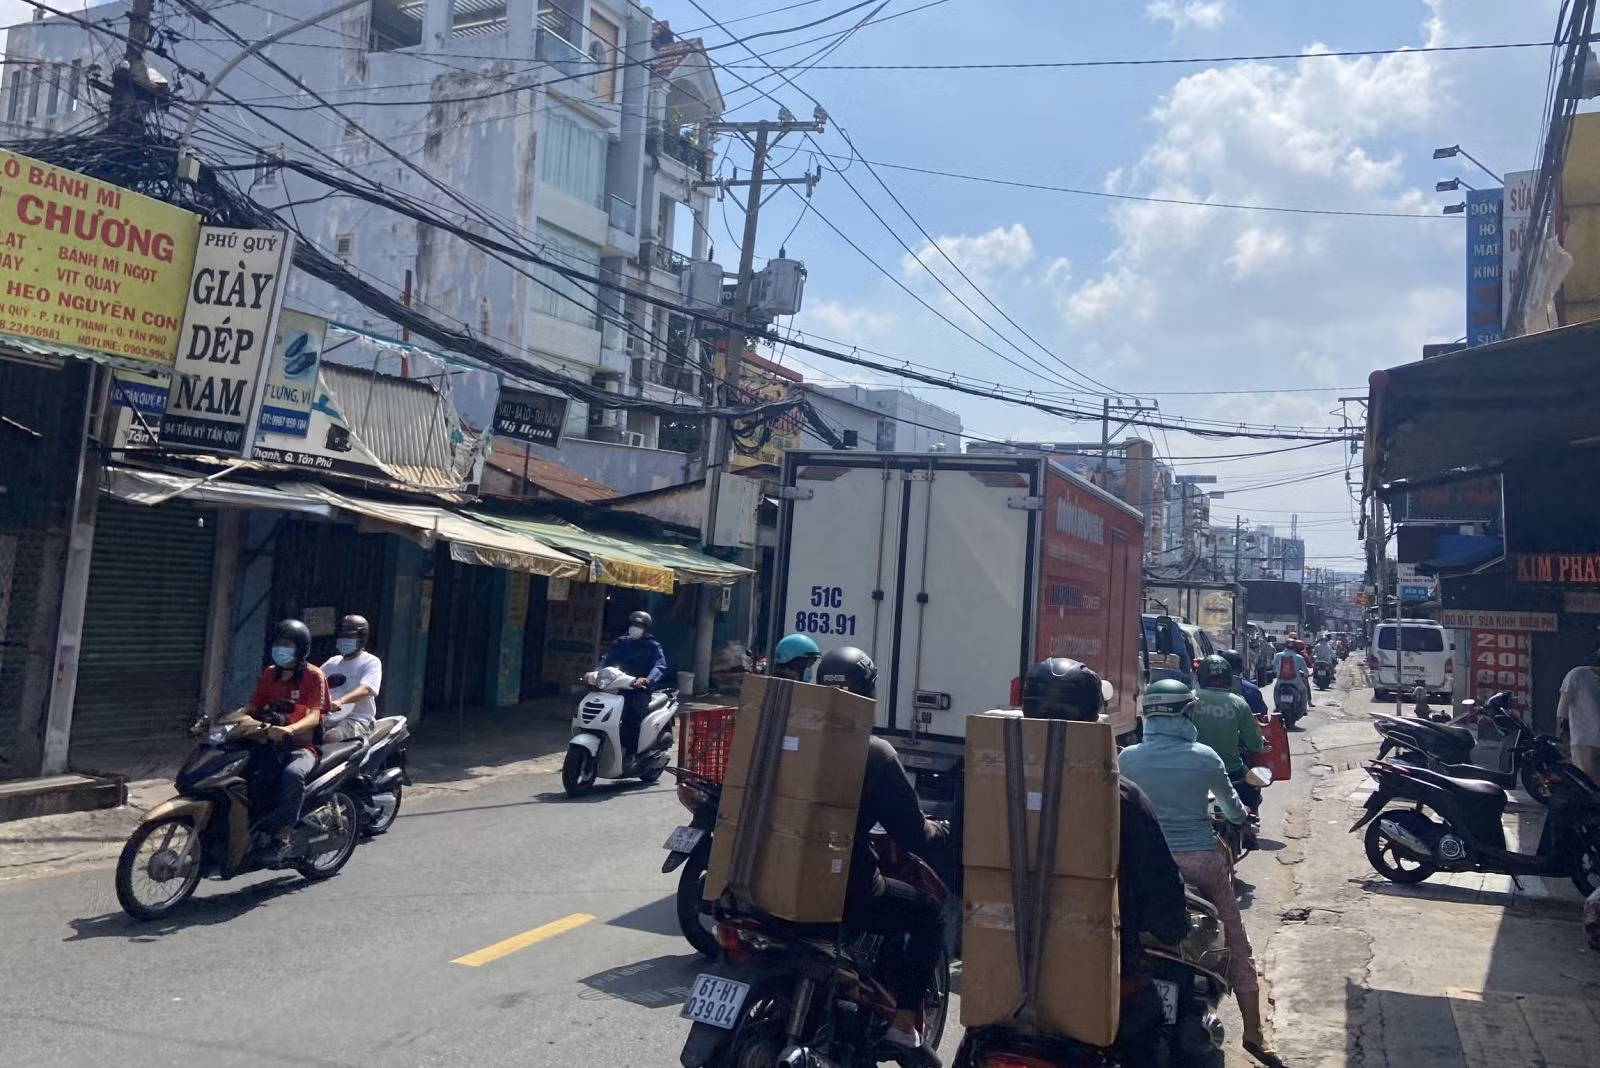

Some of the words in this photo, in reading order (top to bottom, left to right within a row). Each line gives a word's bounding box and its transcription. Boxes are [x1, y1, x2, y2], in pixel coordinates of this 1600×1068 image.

[0, 153, 20, 178] Ò
[28, 165, 89, 200] BÁNH
[96, 184, 122, 210] MÌ
[17, 194, 175, 263] CHƯƠNG
[205, 231, 237, 249] PHÚ
[243, 234, 279, 254] QUÝ
[57, 267, 80, 285] VỊT
[84, 274, 122, 294] QUAY
[193, 259, 274, 310] GIÀY
[7, 280, 51, 303] HEO
[58, 291, 136, 321] NGUYÊN
[141, 310, 178, 331] CON
[186, 315, 255, 366] DÉP
[173, 373, 248, 417] NAM
[519, 423, 553, 438] Hạnh
[298, 453, 314, 465] Tân
[315, 456, 333, 468] Phú
[1517, 555, 1553, 582] KIM
[811, 586, 842, 609] 51C
[795, 610, 856, 636] 863.91
[1194, 700, 1236, 720] Grab
[699, 978, 738, 1002] 61-H1
[687, 997, 735, 1025] 039.04
